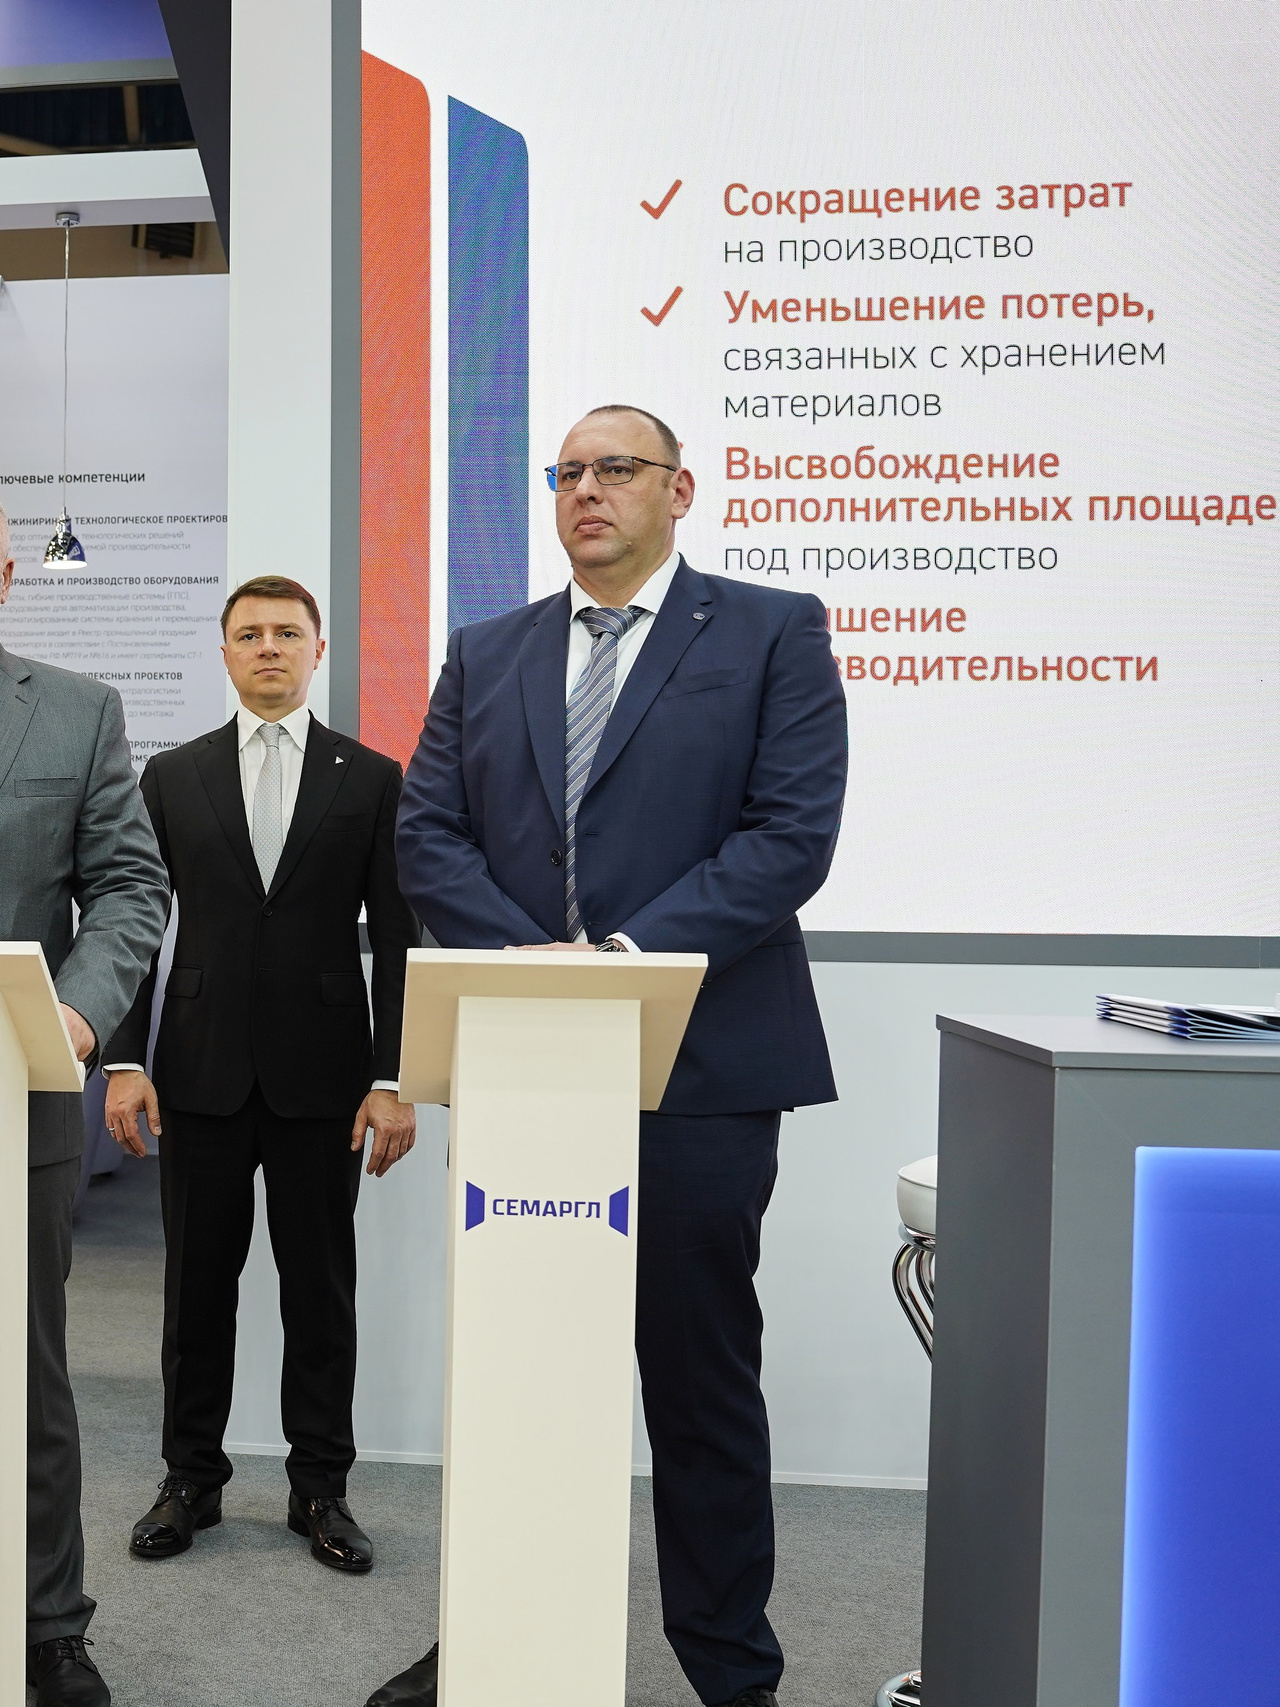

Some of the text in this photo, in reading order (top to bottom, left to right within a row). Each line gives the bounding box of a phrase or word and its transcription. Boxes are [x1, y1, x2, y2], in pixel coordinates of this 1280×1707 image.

[724, 178, 1133, 222] Сокращение затрат
[724, 234, 1034, 269] на производство
[724, 289, 1155, 327] Уменьшение потерь,
[723, 338, 1166, 374] связанных с хранением
[725, 389, 942, 424] материалов
[58, 472, 145, 484] компетенции
[725, 445, 1060, 483] Высвобождение
[8, 518, 58, 526] ЖИНИРИН
[75, 516, 164, 525] ТЕХНОЛОГИЧЕСКОЕ
[167, 515, 228, 523] ПРОЕКТИРОВ
[723, 491, 1278, 528] дополнительных площаде
[82, 532, 146, 540] технологических
[149, 531, 184, 539] решений
[108, 543, 191, 551] производительности
[725, 546, 1059, 578] под производство
[10, 575, 219, 586] ЗРАБОТКА И ПРОИЗВОДСТВО ОБОРУДОВАНИЯ
[827, 607, 966, 633] шение
[134, 672, 183, 681] ПРОЕКТОВ
[834, 654, 1159, 686] водительности
[492, 1198, 601, 1219] СЕМАРГЛ
